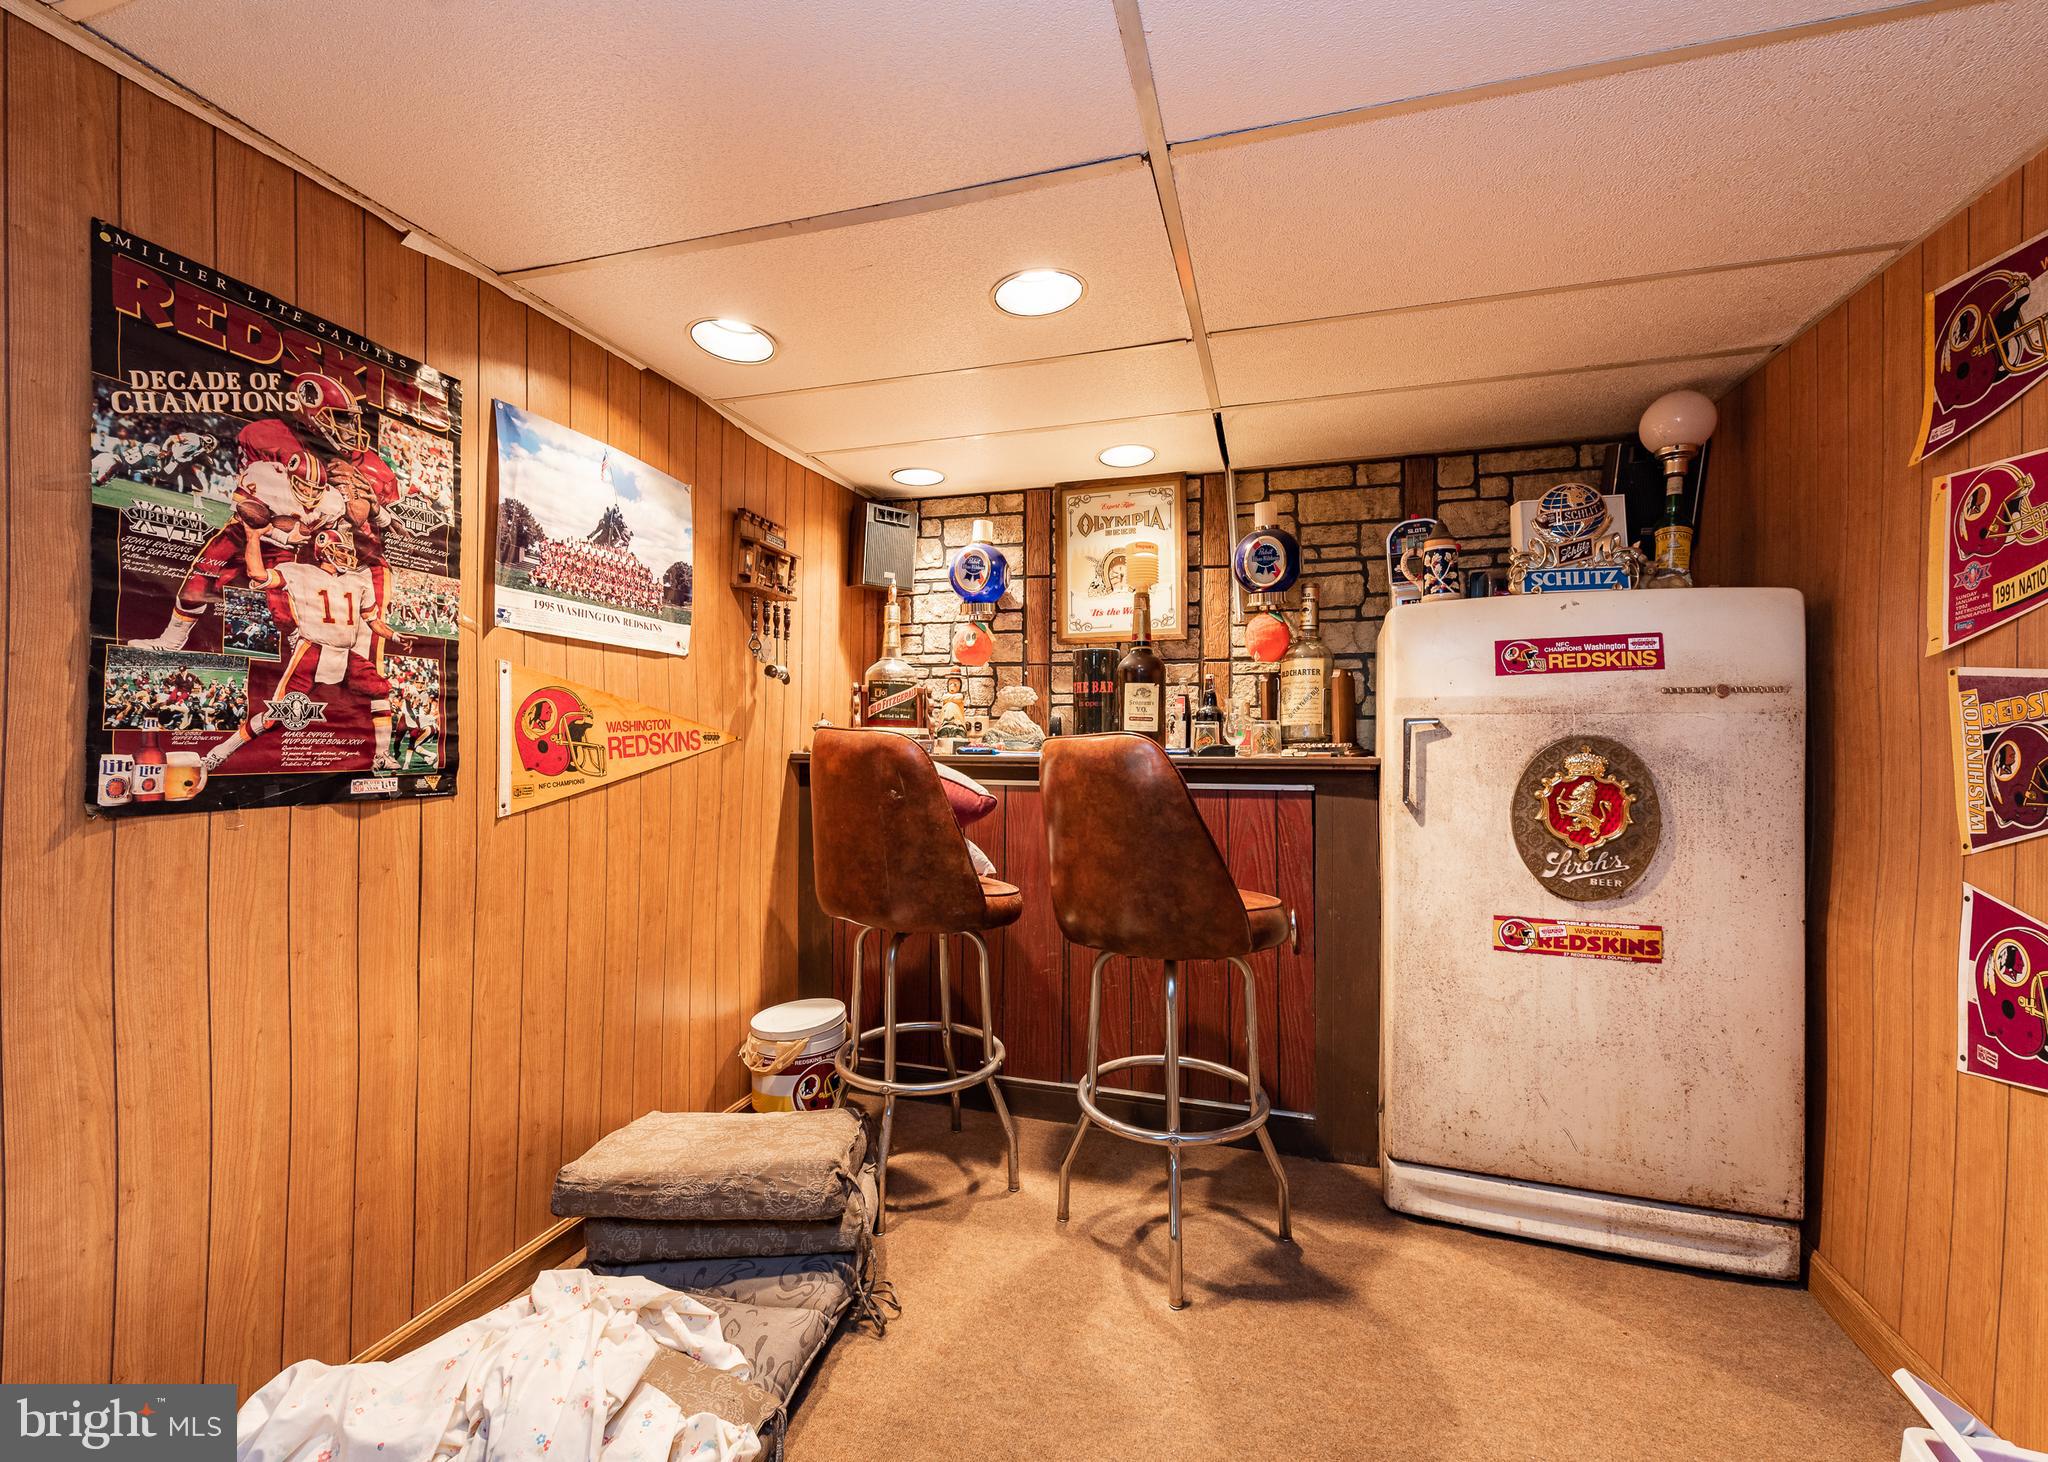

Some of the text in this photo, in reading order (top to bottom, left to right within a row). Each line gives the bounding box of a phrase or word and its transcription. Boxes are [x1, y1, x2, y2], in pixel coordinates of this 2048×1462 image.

[114, 232, 408, 369] MILLER LITE SALUTES
[129, 369, 282, 391] DECADE OF
[110, 390, 302, 414] CHAMPIONS
[406, 497, 428, 510] SUPER
[132, 508, 169, 524] SUPER
[1076, 506, 1166, 538] OLYMPIA
[406, 520, 427, 532] BOWL
[121, 535, 194, 554] JOHN RIGGINS
[121, 543, 146, 553] MVP
[145, 547, 181, 560] SUPER
[1560, 541, 1591, 562] Schlitz
[1530, 569, 1619, 586] SCHLITZ
[1995, 582, 2016, 604] 1991
[2019, 566, 2048, 596] NATIO
[1955, 596, 1980, 606] JANUARY
[1956, 591, 1978, 600] SUNDAY
[318, 589, 355, 626] 11
[1106, 607, 1121, 616] the
[1954, 608, 1992, 621] MINNEAPOLIS
[1955, 603, 1991, 616] METRODOME
[534, 599, 555, 611] 1995
[556, 604, 621, 624] WASHINGTON
[622, 618, 663, 633] REDSKINS
[1583, 643, 1626, 652] Washington
[1548, 650, 1658, 669] REDSKINS
[1289, 667, 1321, 677] CHARTER
[1091, 680, 1114, 694] BAR
[605, 719, 671, 734] WASHINGTON
[607, 729, 702, 760] REDSKINS
[102, 760, 133, 776] Lite
[1962, 693, 1985, 832] WASHINGTON
[140, 766, 162, 777] Lite
[381, 780, 396, 789] Lite
[538, 778, 586, 790] NFC CHAMPIONS
[1541, 849, 1630, 883] Stroh's
[1589, 878, 1623, 887] BEER
[1575, 928, 1623, 937] WASHINGTON
[1588, 922, 1640, 930] CHAMPIONS
[1537, 933, 1661, 956] REDSKINS
[794, 1055, 823, 1066] REDSKINS
